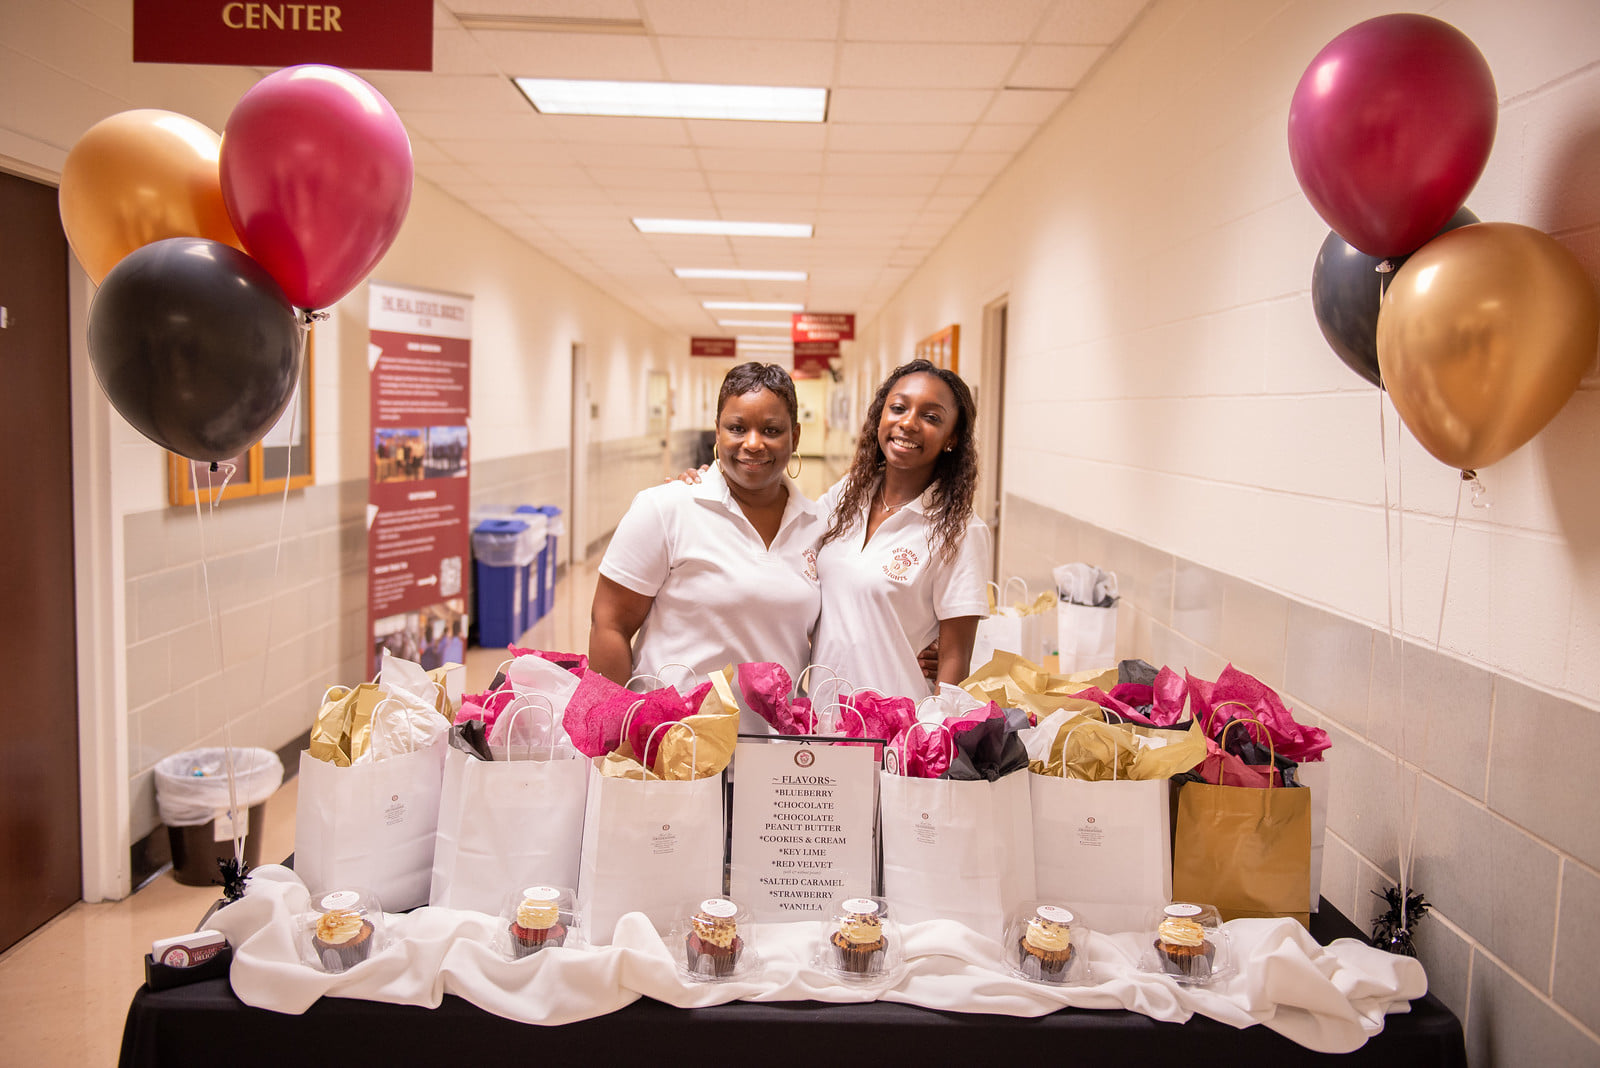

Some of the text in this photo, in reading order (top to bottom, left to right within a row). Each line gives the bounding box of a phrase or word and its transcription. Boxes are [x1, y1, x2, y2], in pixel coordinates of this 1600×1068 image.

[222, 2, 343, 32] CENTER
[892, 547, 919, 565] DECADENT
[882, 565, 908, 581] DELIGHTS
[765, 823, 841, 832] PEANUT BUTTER
[814, 837, 846, 845] CREAM
[803, 849, 826, 857] LIME
[797, 861, 833, 869] VELVET
[800, 878, 844, 887] CARAMEL
